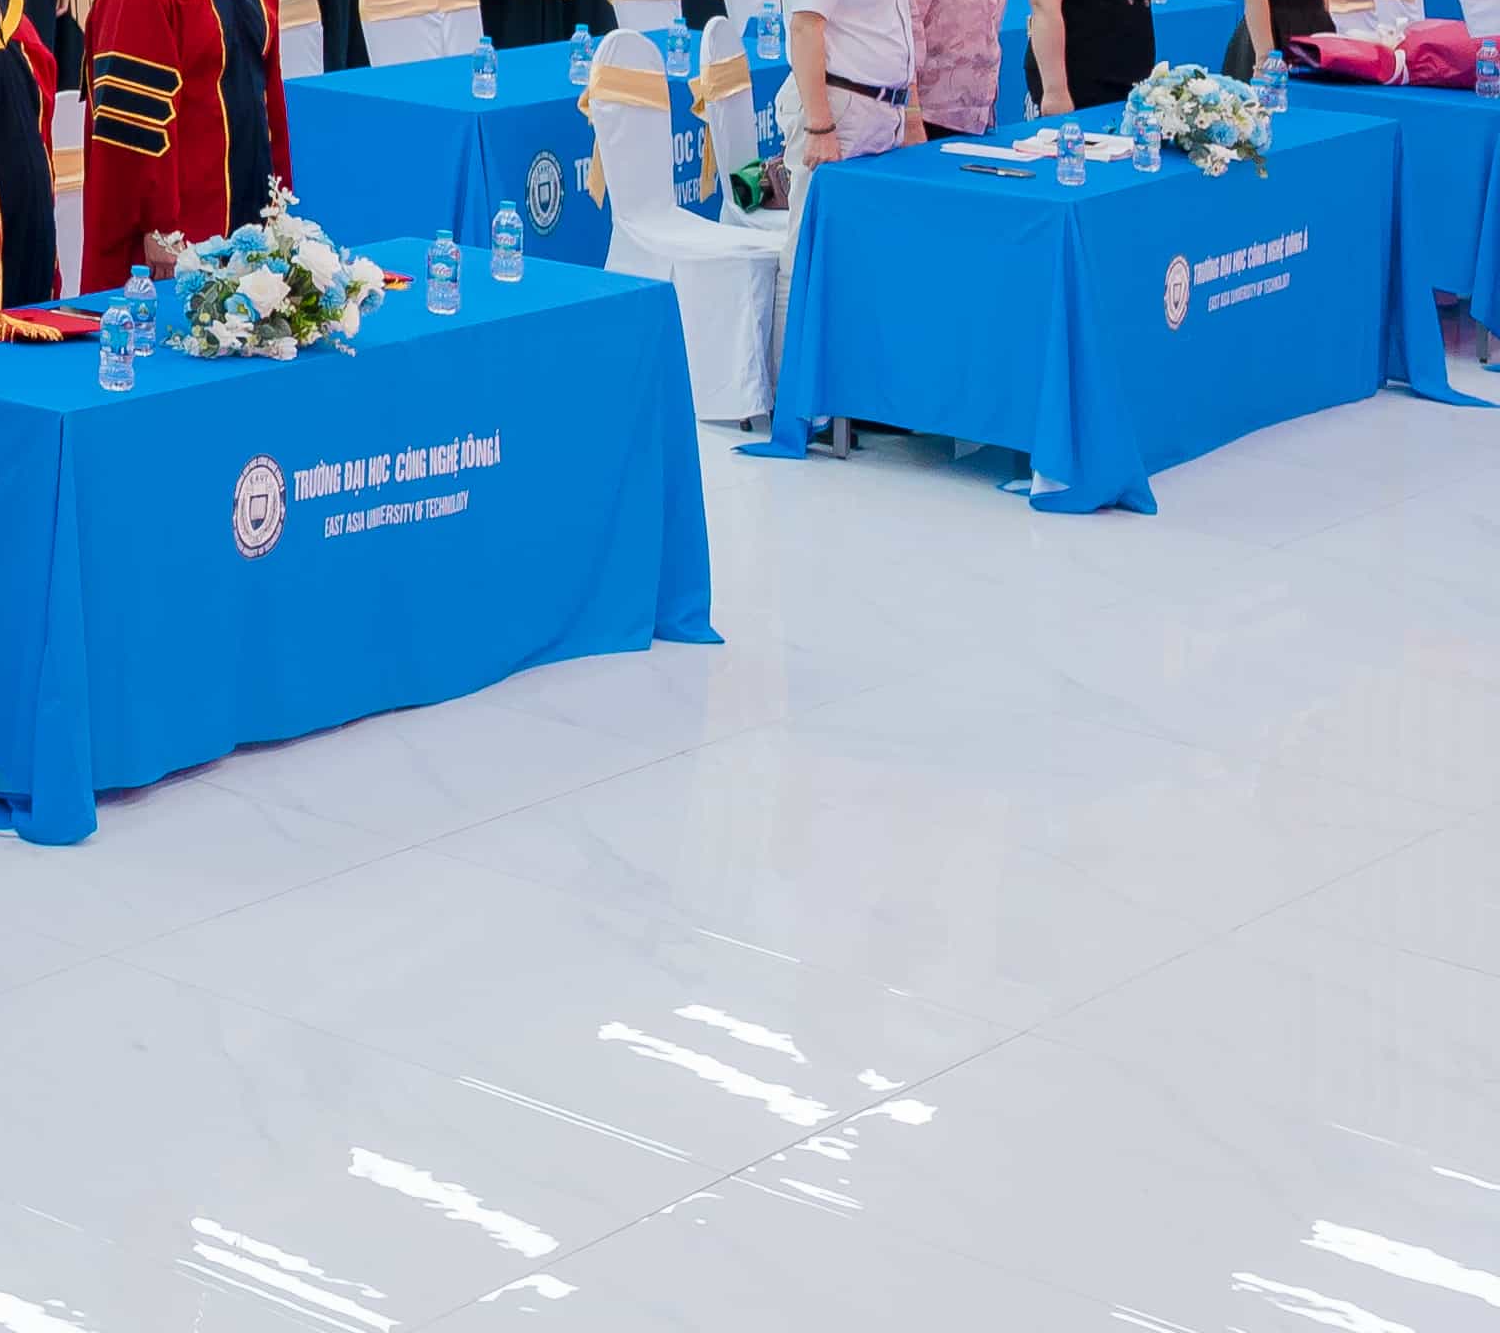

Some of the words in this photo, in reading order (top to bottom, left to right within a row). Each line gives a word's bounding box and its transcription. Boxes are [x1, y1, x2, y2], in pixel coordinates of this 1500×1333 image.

[674, 130, 694, 172] ỌC
[293, 459, 341, 501] TRƯỜNG
[344, 458, 365, 496] ĐẠI
[368, 453, 390, 492] HỌC
[429, 437, 459, 479] NGHỆ
[325, 515, 346, 538] EAST
[346, 511, 364, 533] ASIA
[415, 500, 424, 521] OF
